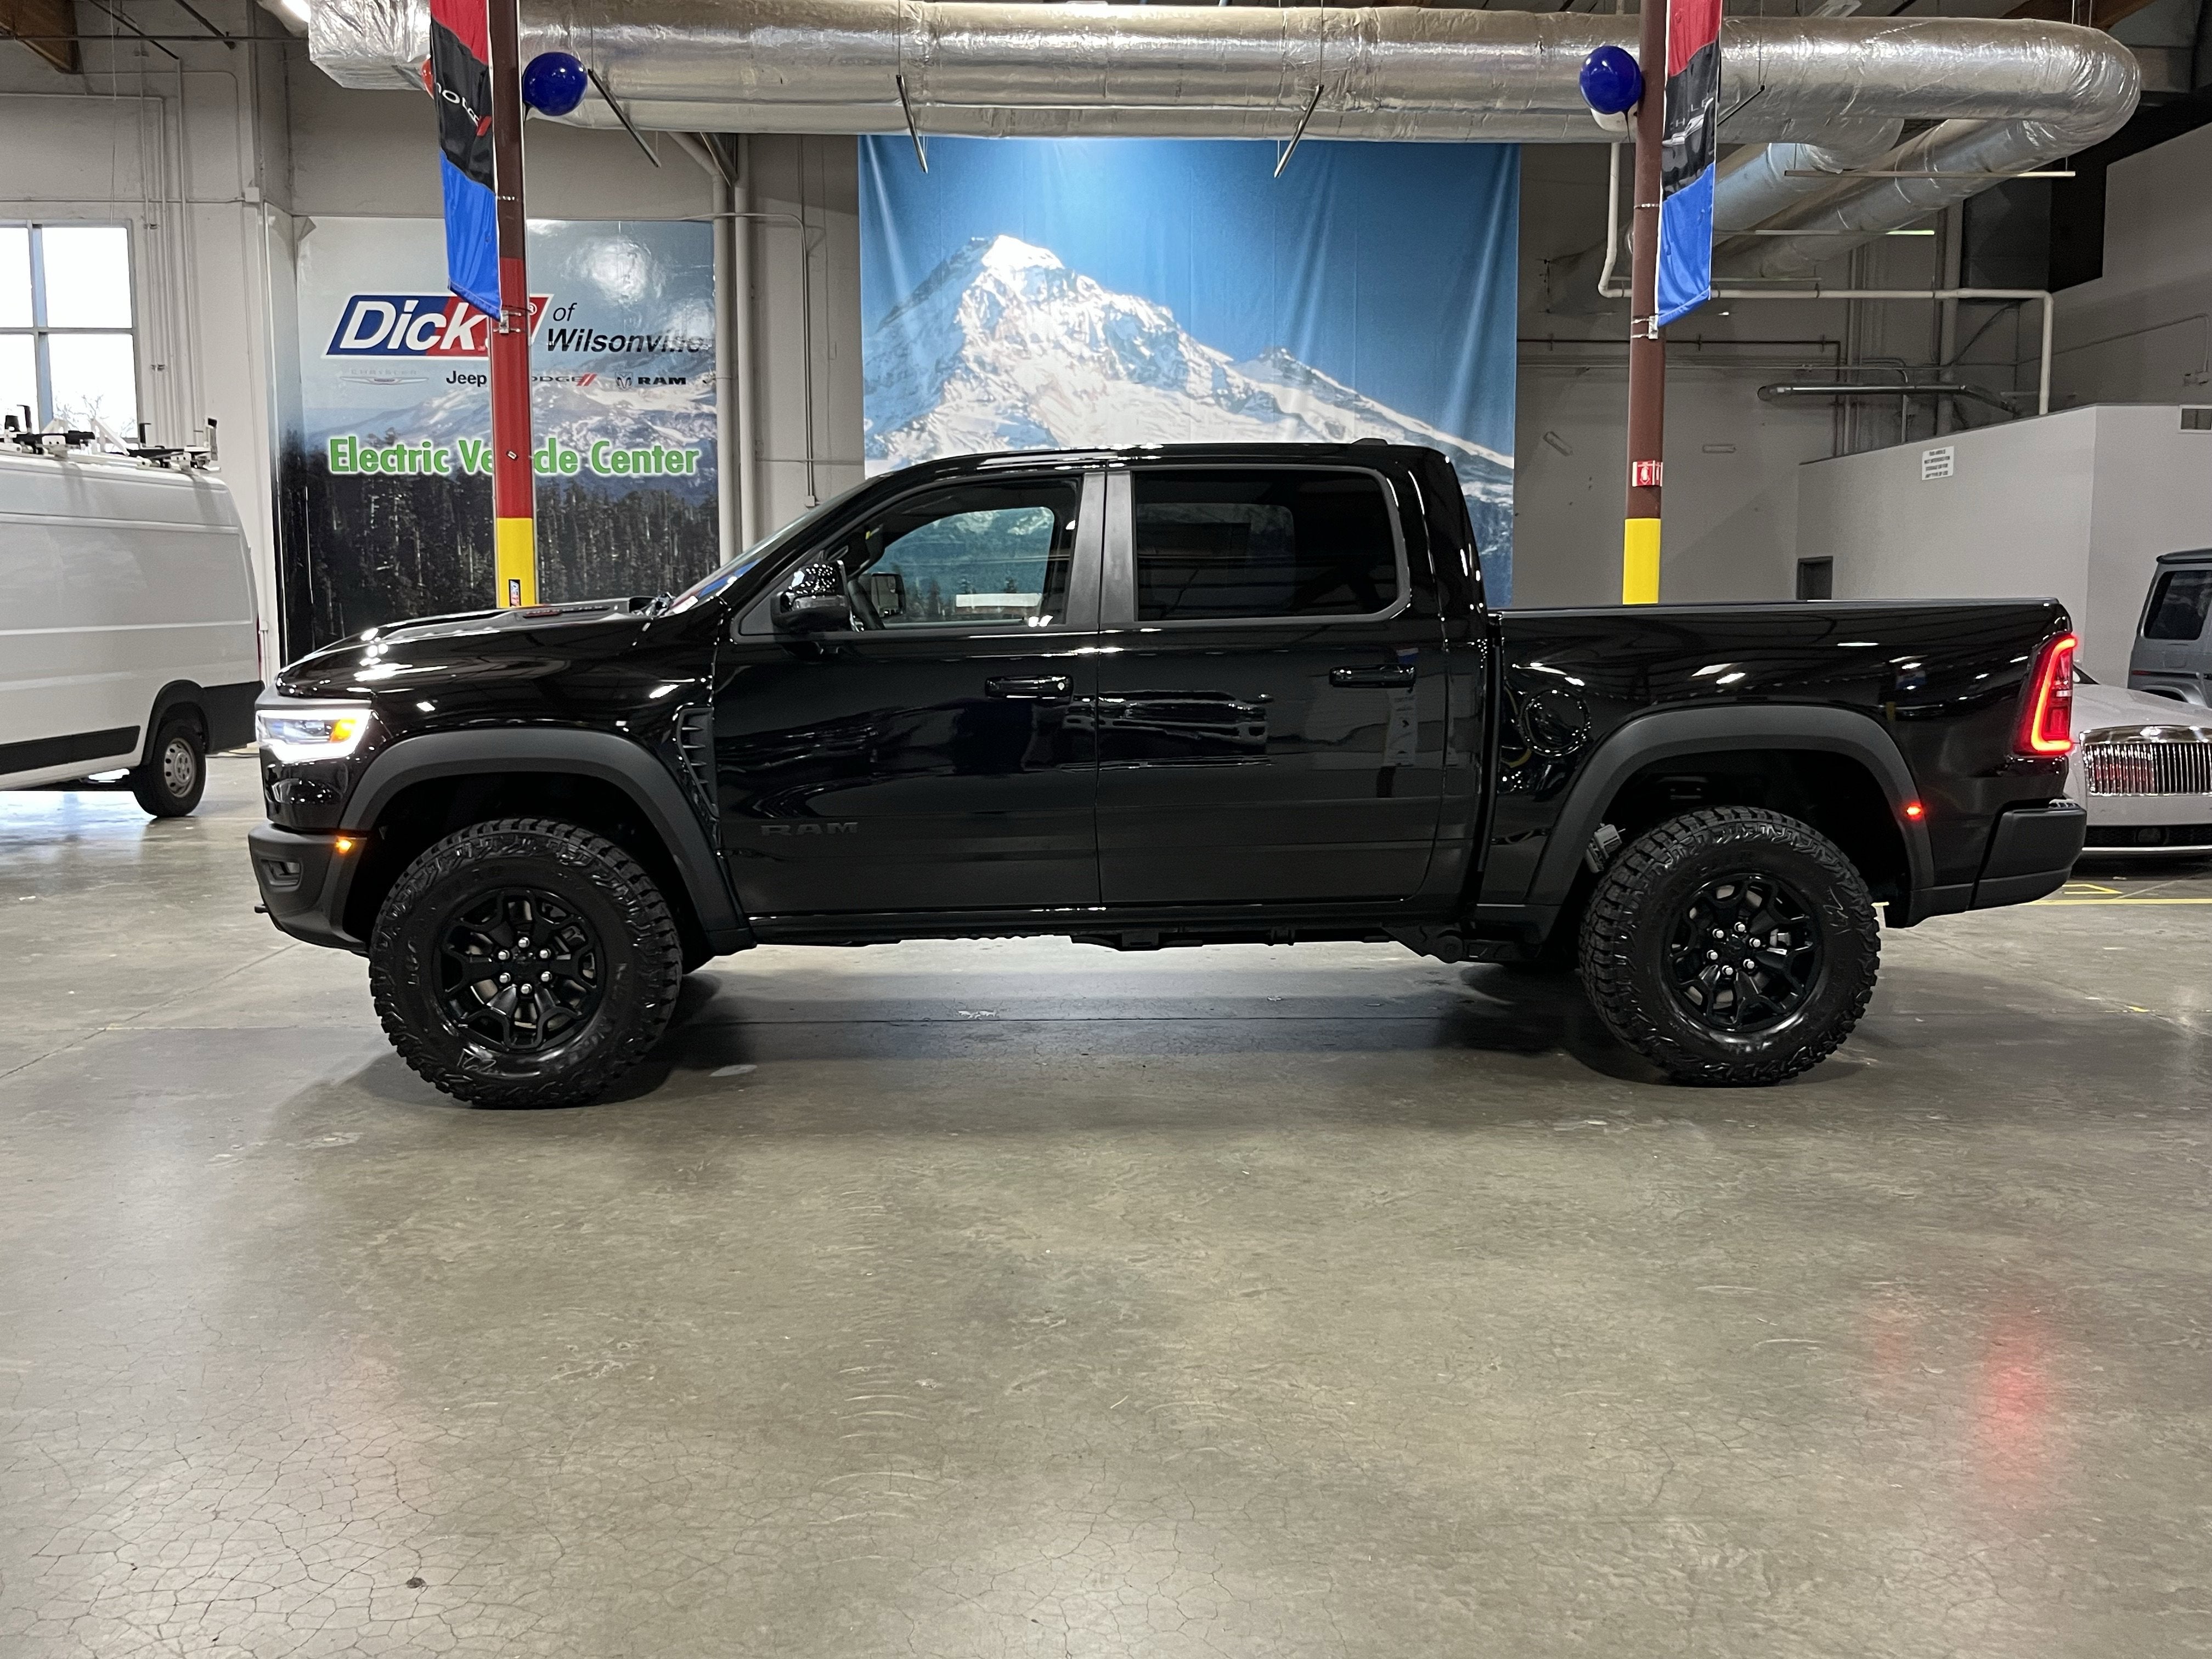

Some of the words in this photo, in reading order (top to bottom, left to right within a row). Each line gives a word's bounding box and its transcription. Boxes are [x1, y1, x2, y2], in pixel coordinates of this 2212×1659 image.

[340, 300, 488, 350] Dick
[552, 303, 578, 322] of
[548, 329, 701, 352] Wilsonvi
[446, 371, 487, 387] Jeep
[637, 377, 686, 385] RAM
[330, 436, 449, 473] Electric
[459, 438, 579, 475] Vecle
[591, 441, 700, 474] Center
[761, 822, 859, 836] RAM
